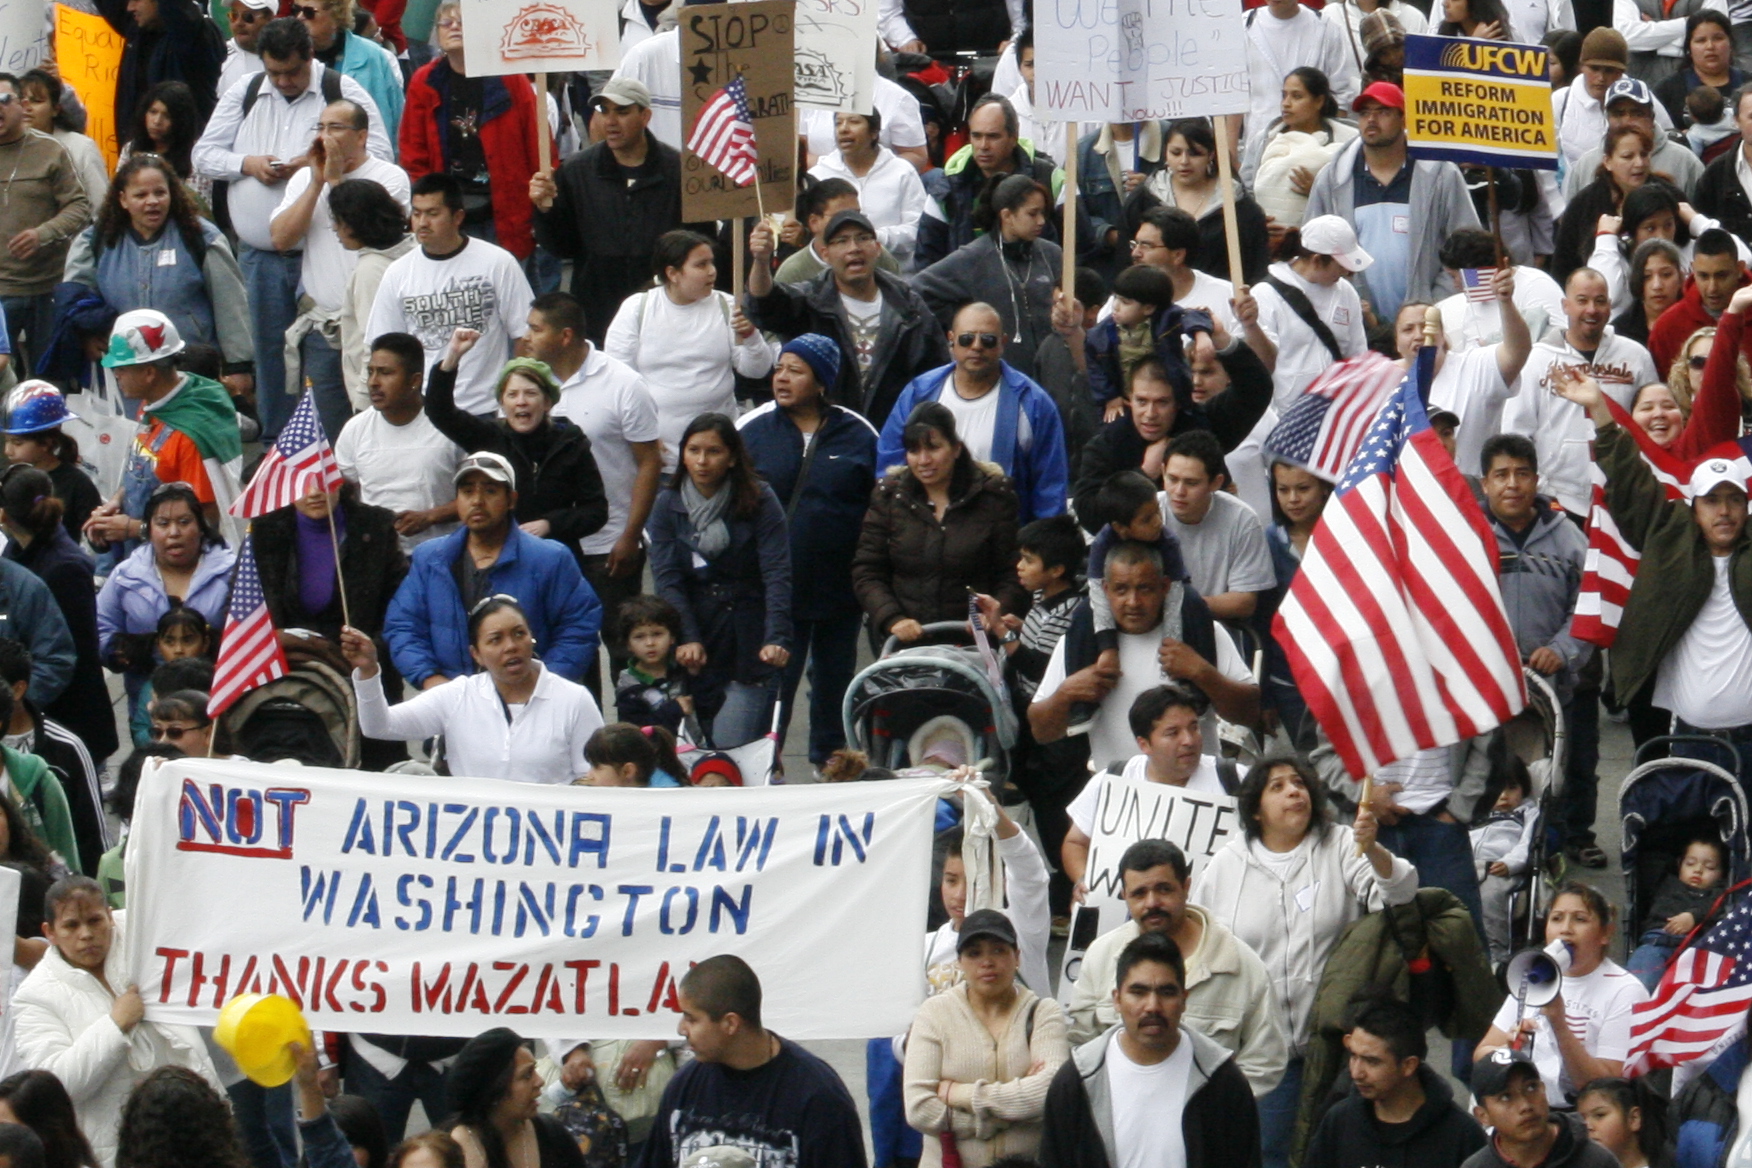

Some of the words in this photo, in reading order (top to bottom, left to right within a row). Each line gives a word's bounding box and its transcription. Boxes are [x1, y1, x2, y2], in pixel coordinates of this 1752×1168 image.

[690, 14, 769, 55] STOP
[1462, 42, 1547, 78] UFCW
[1046, 79, 1133, 110] WANT
[1154, 73, 1250, 99] JUSTICE
[1439, 80, 1517, 103] REFORM
[1414, 98, 1545, 125] IMMIGRATION
[1415, 119, 1455, 138] FOR
[1460, 121, 1547, 146] AMERICA
[403, 289, 482, 312] SOUTH
[417, 306, 482, 328] POLE
[177, 776, 312, 852] NOT
[341, 797, 613, 871] ARIZONA
[656, 813, 780, 874] LAW
[812, 811, 876, 868] IN
[1098, 787, 1236, 857] UNITE
[299, 864, 755, 939] WASHINGTON
[154, 946, 389, 1014] THANKS
